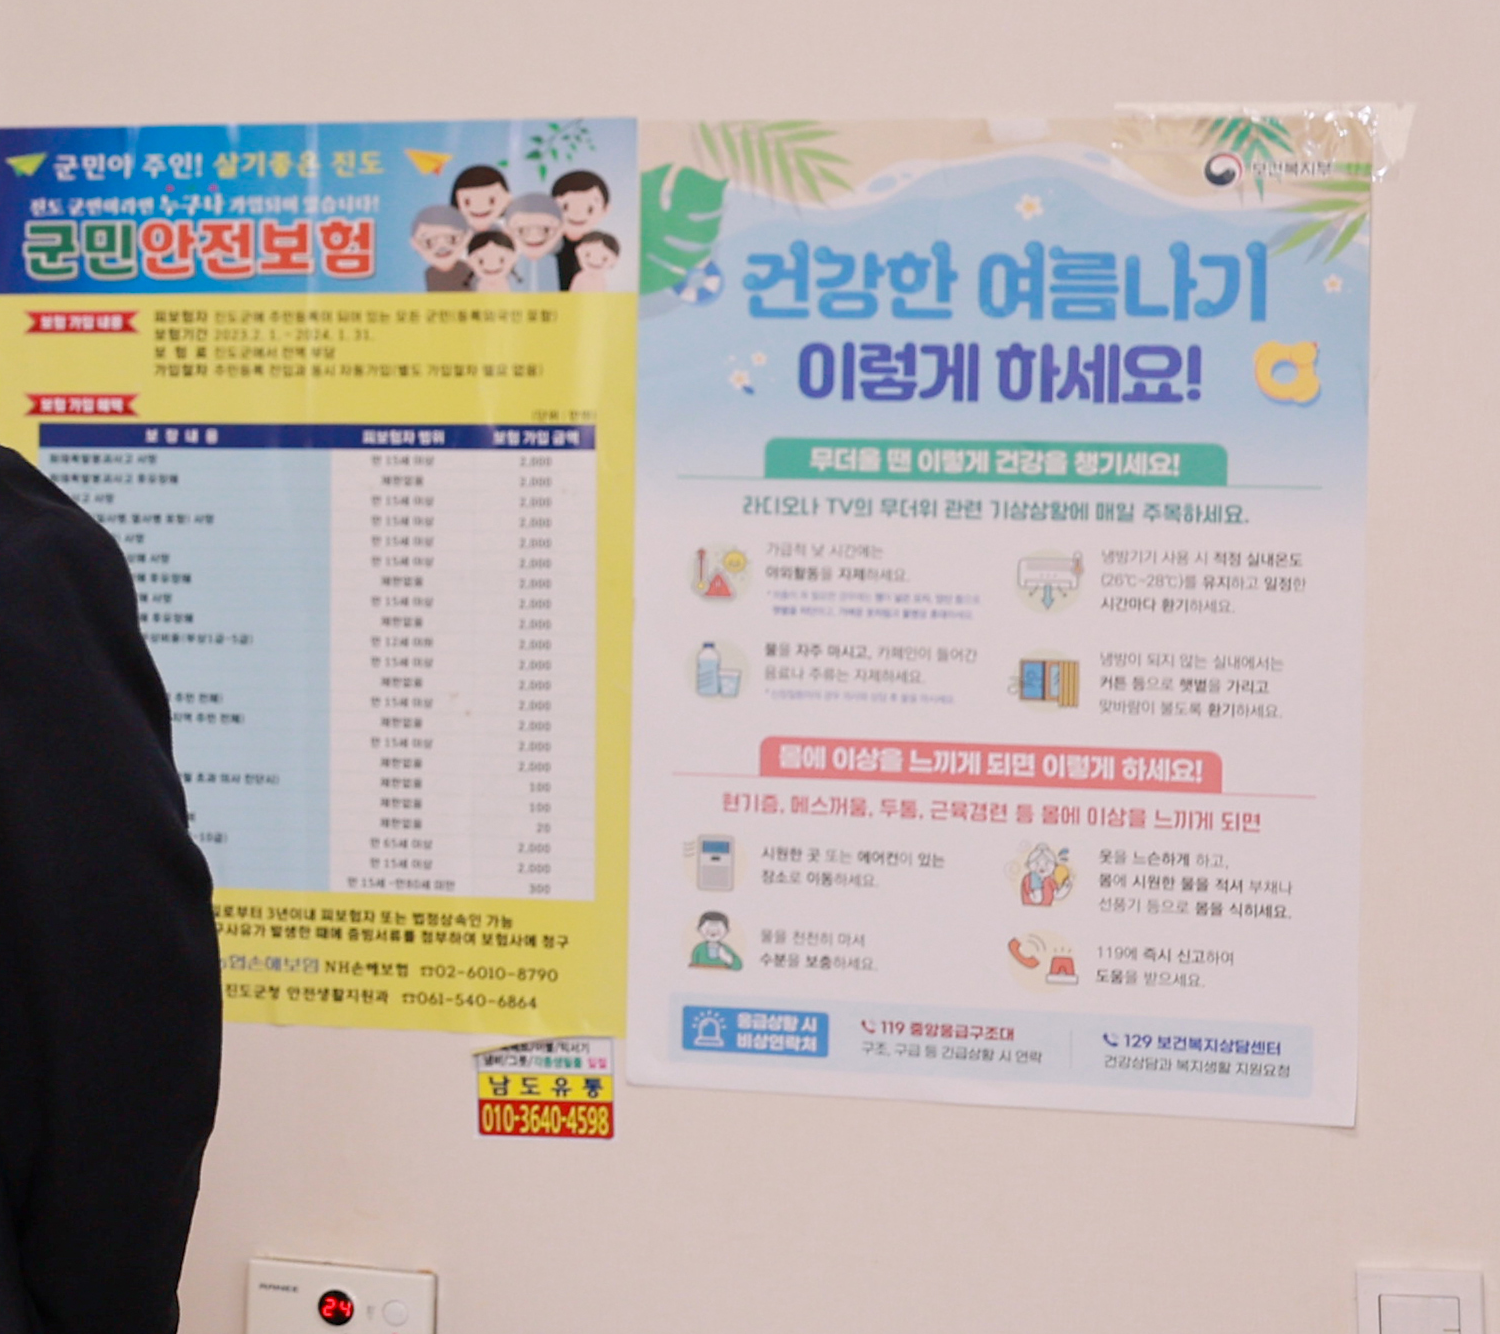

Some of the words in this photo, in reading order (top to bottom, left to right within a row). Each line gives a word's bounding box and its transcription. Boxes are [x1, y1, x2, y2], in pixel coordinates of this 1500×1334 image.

[53, 153, 132, 181] 군민이
[142, 151, 204, 180] 주인!
[213, 151, 322, 179] 살기좋은
[331, 150, 384, 178] 진도
[23, 218, 376, 282] 군민안전보험
[743, 239, 959, 320] 건강한
[978, 240, 1267, 322] 여름나기
[797, 341, 980, 404] 이렇게
[995, 342, 1202, 405] 하세요!
[809, 446, 882, 473] 무더울
[888, 447, 912, 474] 땐
[917, 448, 989, 475] 이렇게
[996, 449, 1069, 476] 건강을
[1074, 450, 1181, 478] 챙기세요!
[742, 496, 820, 518] 라디오나
[827, 497, 872, 518] TV의
[879, 498, 938, 520] 무더위
[944, 499, 983, 521] 관련
[992, 499, 1090, 523] 기상상황에
[1097, 501, 1135, 523] 매일
[1142, 502, 1250, 526] 주목하세요.
[1101, 550, 1157, 566] 냉방기기
[1162, 550, 1189, 566] 사용
[1195, 551, 1208, 566] 시
[1214, 551, 1242, 567] 적정
[1247, 552, 1303, 568] 실내온도
[1101, 597, 1156, 612] 시간마다
[1162, 598, 1236, 614] 환기하세요.
[779, 745, 827, 771] 몸에
[832, 747, 903, 772] 이상을
[910, 748, 982, 778] 느끼게
[987, 753, 1035, 779] 되면
[1042, 754, 1115, 780] 이렇게
[1122, 756, 1203, 784] 하세요!
[722, 792, 785, 815] 현기증,
[791, 795, 874, 819] 메스꺼움,
[879, 799, 924, 822] 두통,
[931, 799, 1009, 824] 근육경련
[1017, 804, 1034, 825] 등
[1042, 804, 1080, 826] 몸에
[1087, 806, 1146, 828] 이상을
[1154, 809, 1214, 832] 느끼게
[1221, 810, 1261, 834] 되면
[1100, 873, 1127, 888] 몸에
[1133, 874, 1175, 891] 시원한
[1181, 876, 1209, 892] 물을
[1215, 878, 1243, 894] 적셔
[1250, 880, 1292, 896] 부채나
[267, 906, 315, 922] 3년이내
[321, 907, 375, 924] 피보험자
[380, 910, 407, 925] 또는
[412, 911, 482, 928] 법정상속인
[486, 914, 513, 929] 가능
[1097, 946, 1138, 961] 119에
[1143, 947, 1171, 963] 즉시
[1177, 949, 1235, 967] 신고하여
[324, 960, 409, 978] NH손해보험
[435, 966, 559, 983] 02-6010-8790
[225, 984, 280, 1000] 진도군청
[286, 987, 388, 1004] 안전생활지원과
[416, 992, 538, 1010] 061-540-6864
[880, 1018, 906, 1036] 119
[909, 1020, 1015, 1042] 중앙응급구조대
[861, 1040, 891, 1060] 구조,
[895, 1042, 921, 1060] 구급
[925, 1044, 938, 1060] 등
[941, 1045, 994, 1064] 긴급상황
[998, 1047, 1012, 1064] 시
[1015, 1048, 1043, 1065] 연락
[1123, 1032, 1153, 1050] 129
[1156, 1033, 1281, 1058] 보건복지상담센터
[1103, 1054, 1172, 1073] 건강상담과
[1176, 1057, 1232, 1077] 복지생활
[1235, 1060, 1291, 1080] 지원요청
[488, 1075, 603, 1099] 남도유통
[482, 1103, 609, 1136] 010-3640-4598
[322, 1296, 354, 1318] 24
